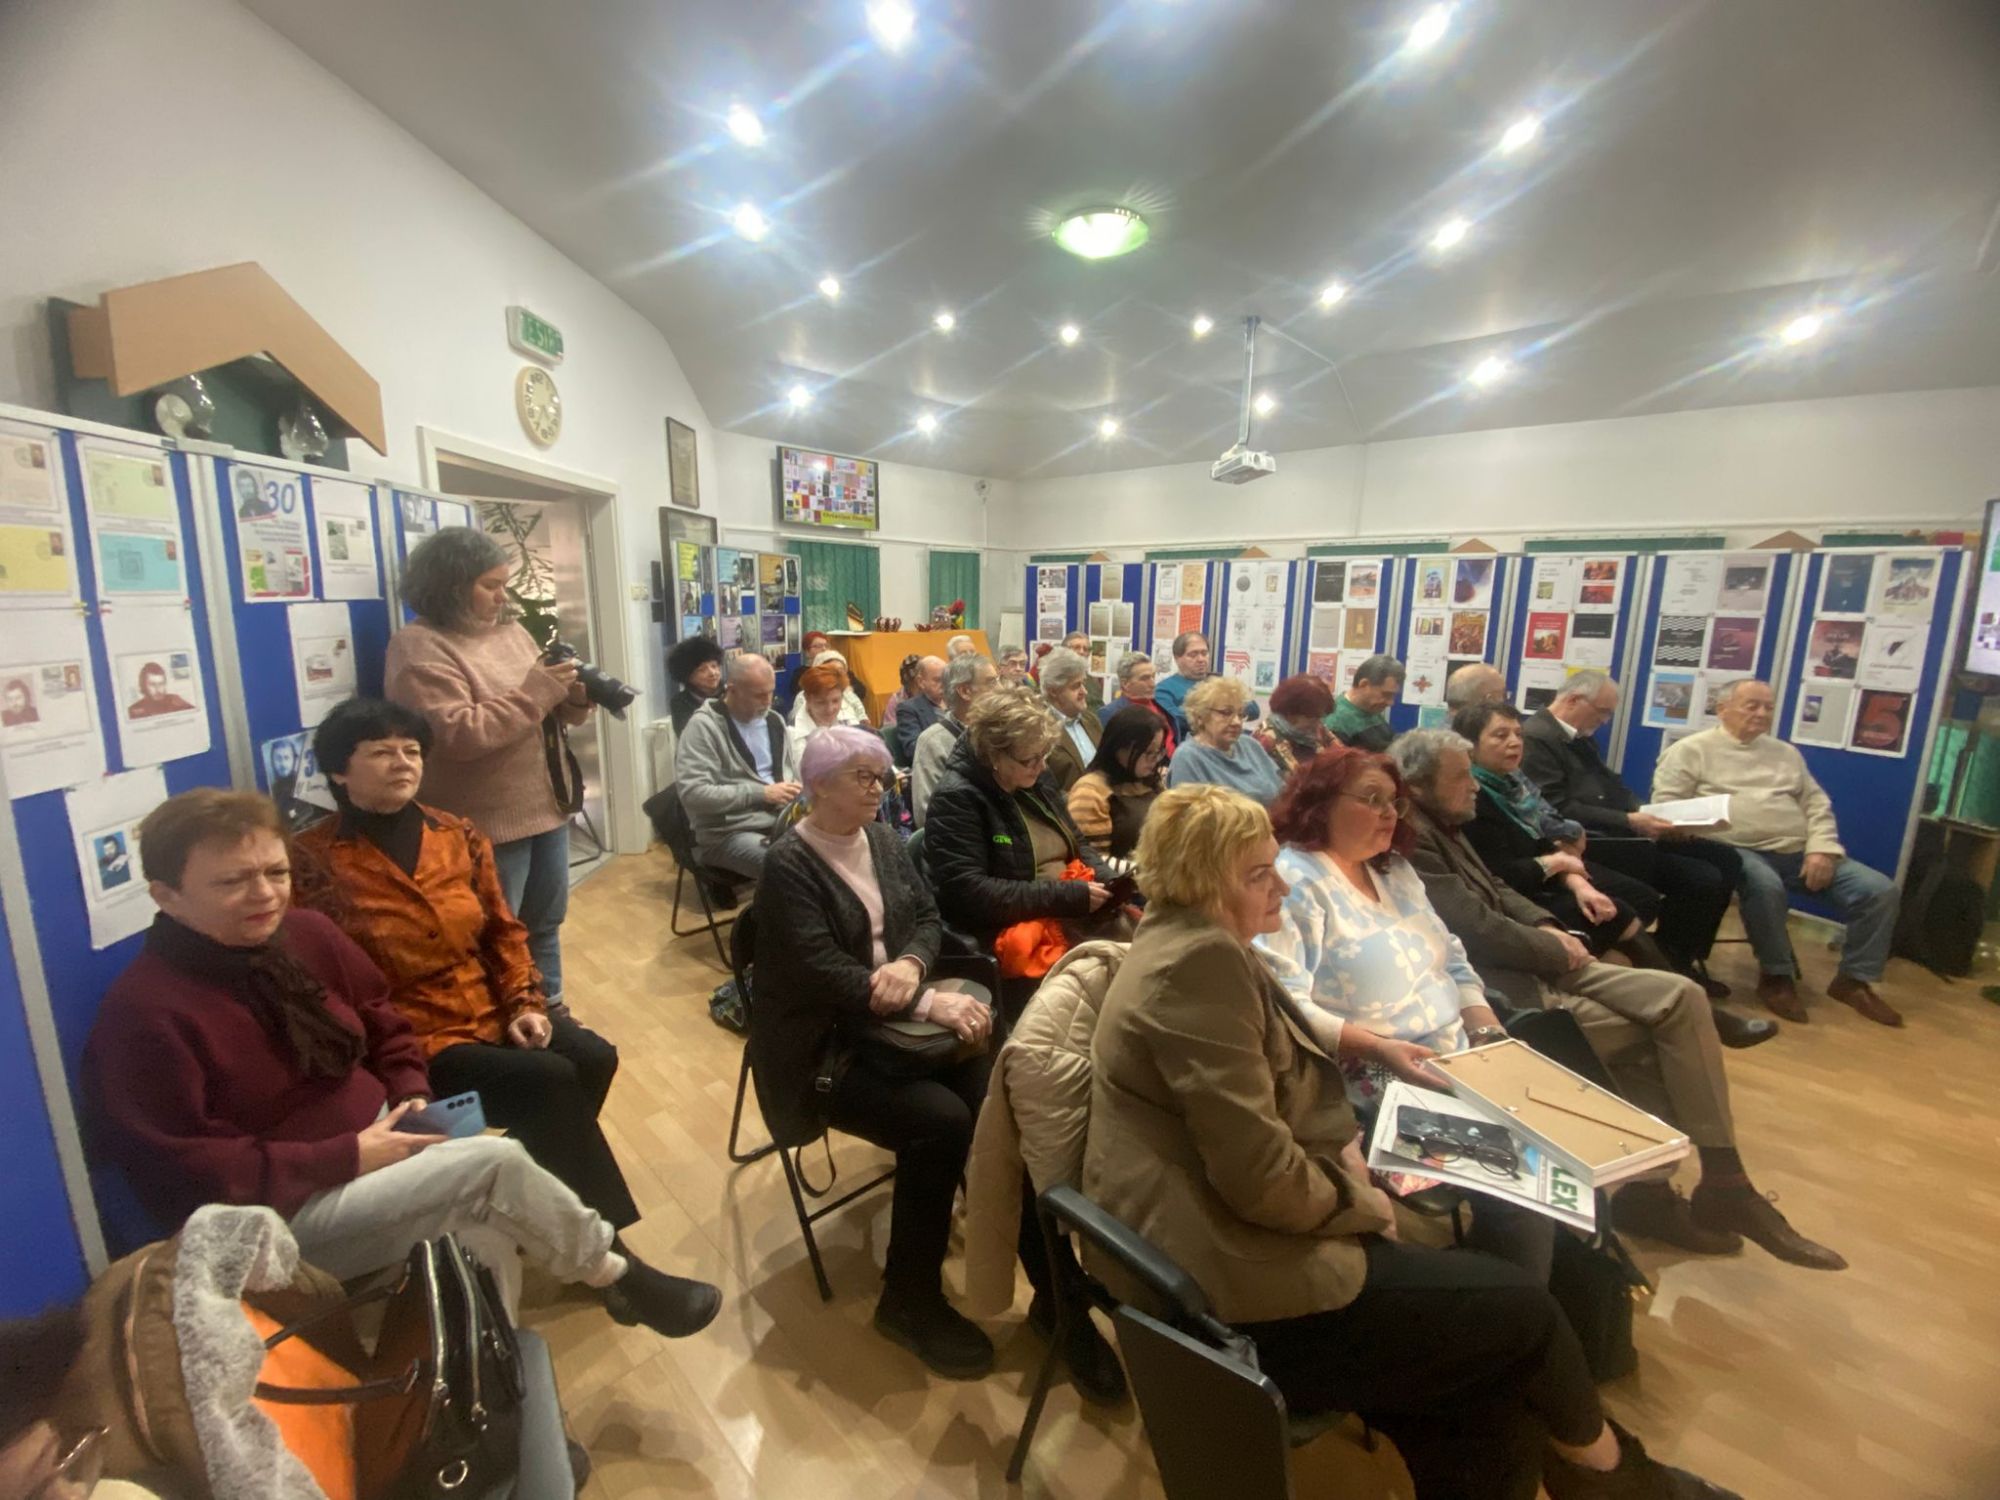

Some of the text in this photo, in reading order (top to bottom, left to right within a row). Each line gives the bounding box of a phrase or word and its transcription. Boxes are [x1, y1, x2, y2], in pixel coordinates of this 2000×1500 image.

[265, 481, 296, 514] 30
[1859, 694, 1904, 747] 5
[1552, 1167, 1578, 1211] LEX
